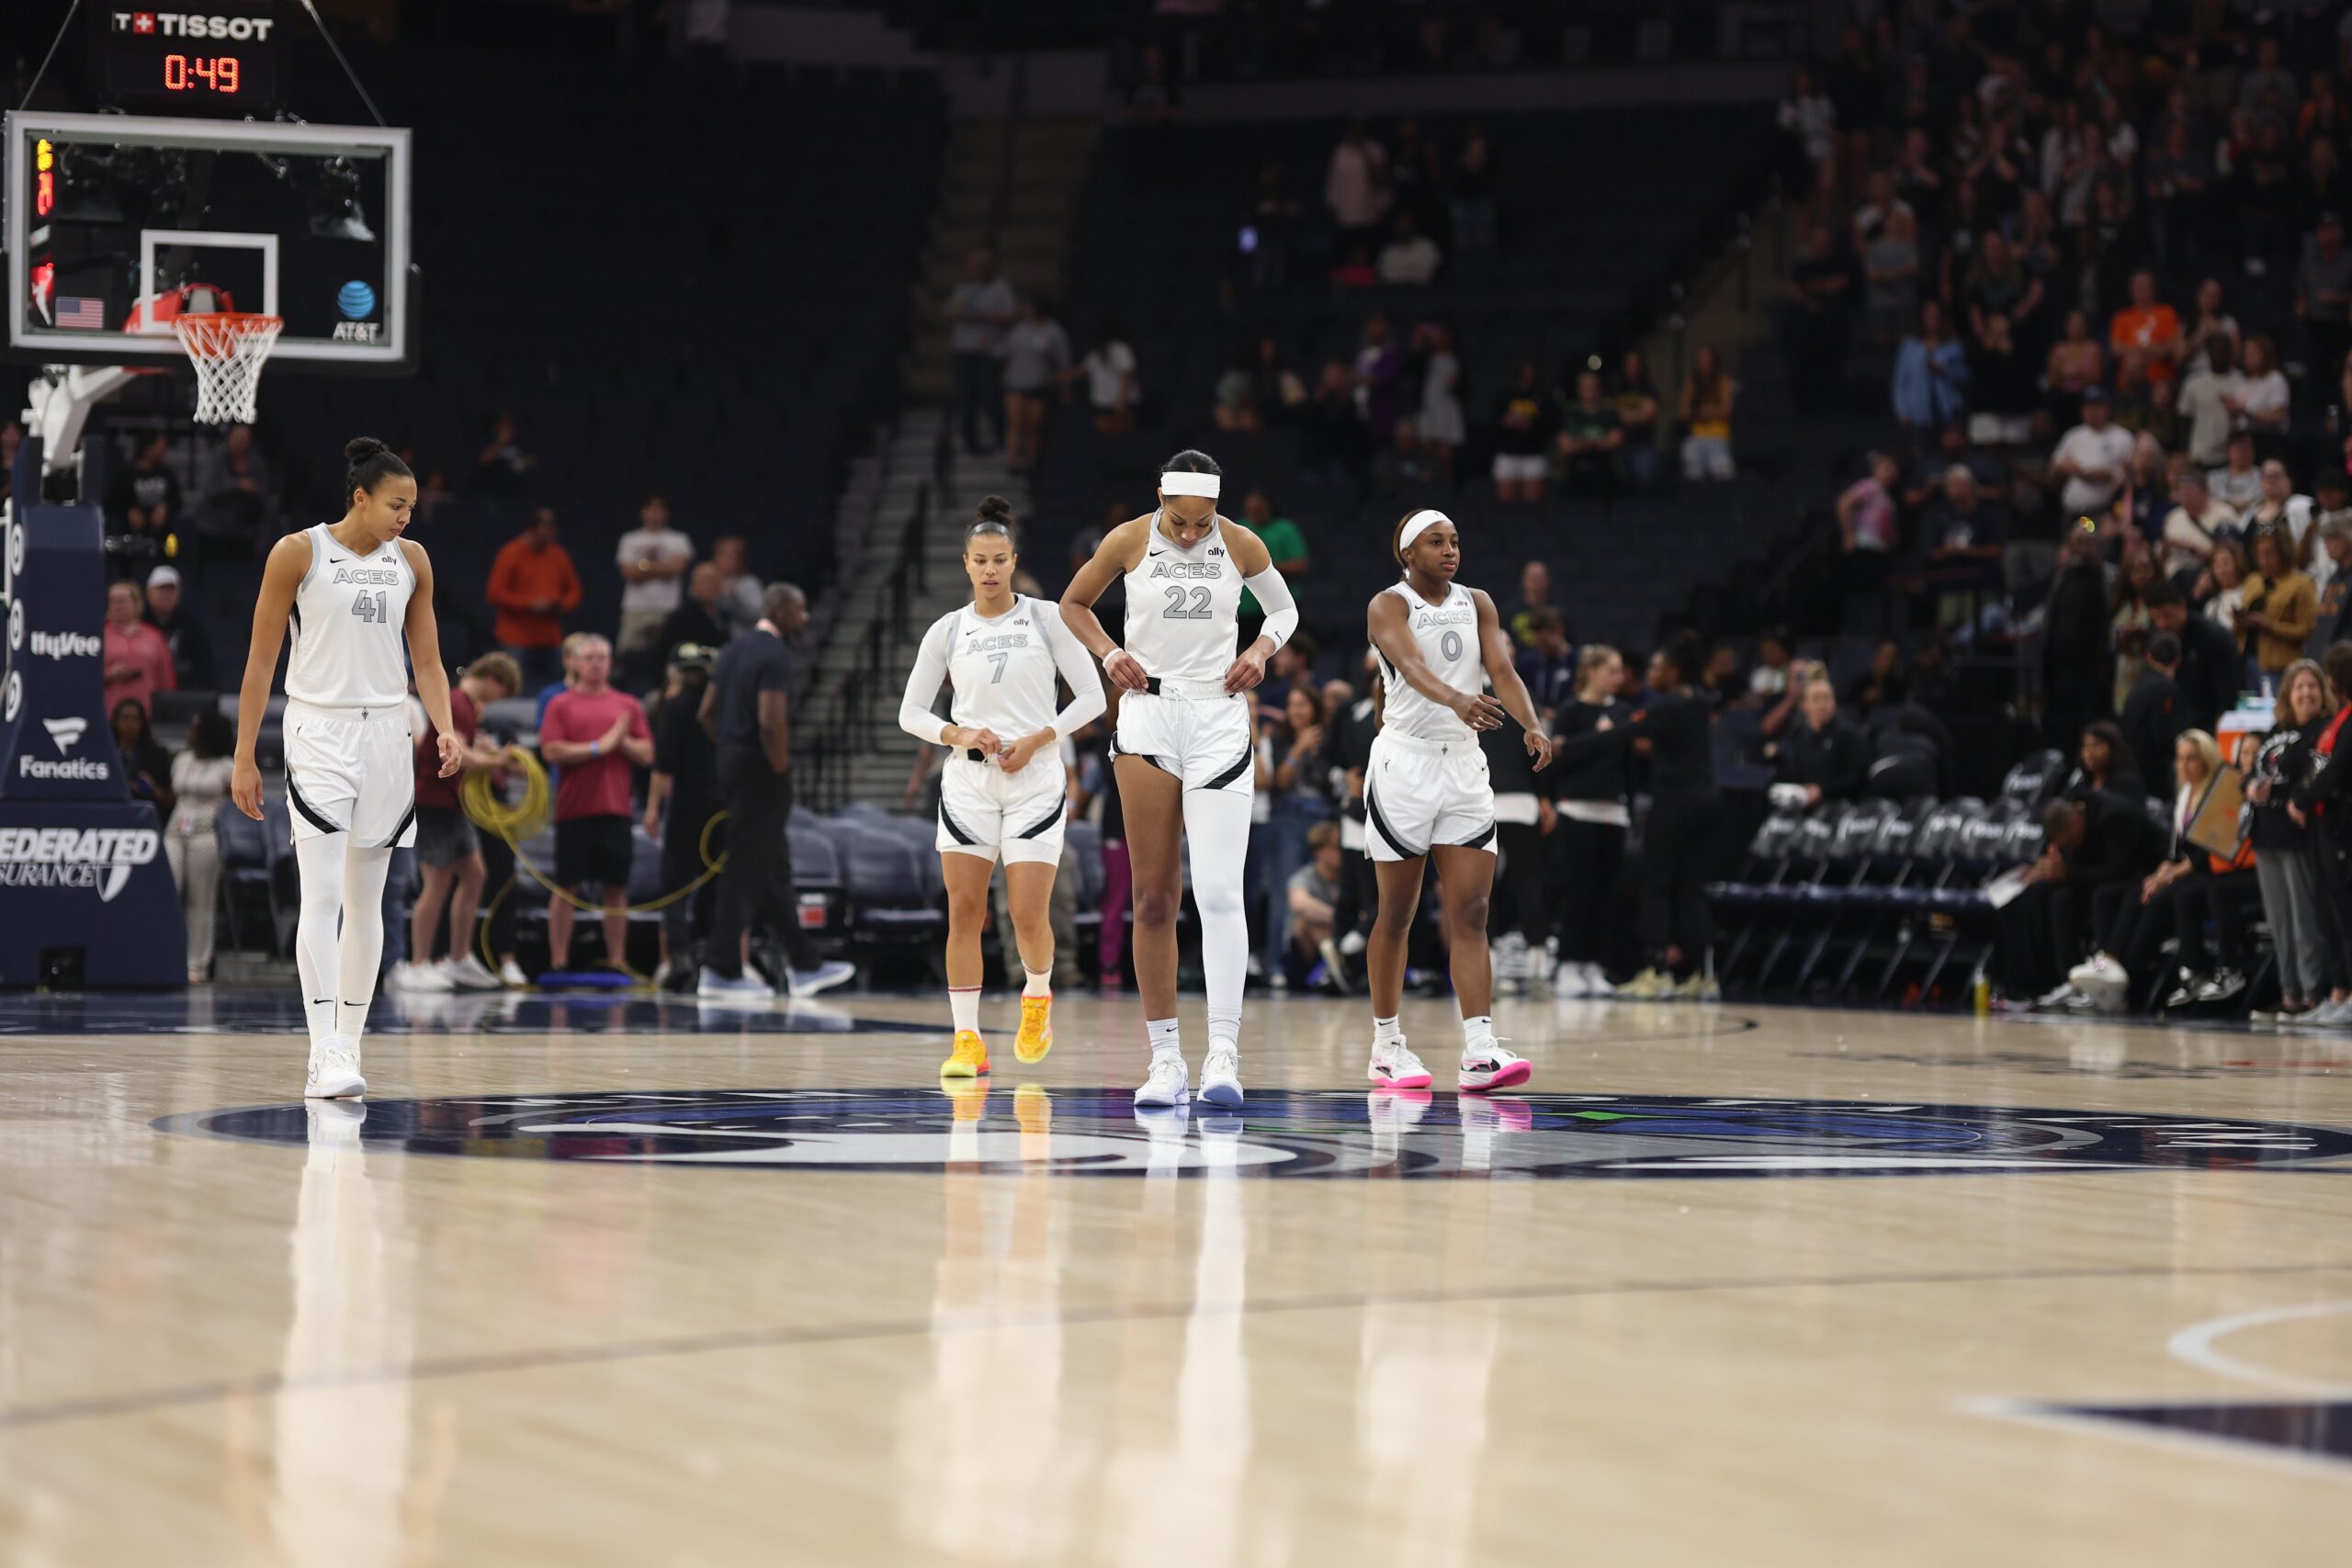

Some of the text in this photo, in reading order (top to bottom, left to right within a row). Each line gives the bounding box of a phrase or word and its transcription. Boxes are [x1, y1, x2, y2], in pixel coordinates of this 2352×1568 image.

[157, 13, 274, 41] TISSOT
[164, 54, 239, 93] 0:49
[333, 321, 379, 344] AT&T
[381, 556, 397, 566] ally
[1207, 547, 1225, 558] ally
[333, 568, 399, 586] ACES
[1150, 562, 1222, 580] ACES
[351, 589, 387, 624] 41
[1163, 585, 1213, 619] 22
[1013, 618, 1029, 626] ally
[1417, 610, 1474, 629] ACES
[967, 633, 1028, 655] ACES
[1441, 630, 1464, 662] 0
[987, 652, 1008, 684] 7
[19, 754, 109, 780] Fanatics
